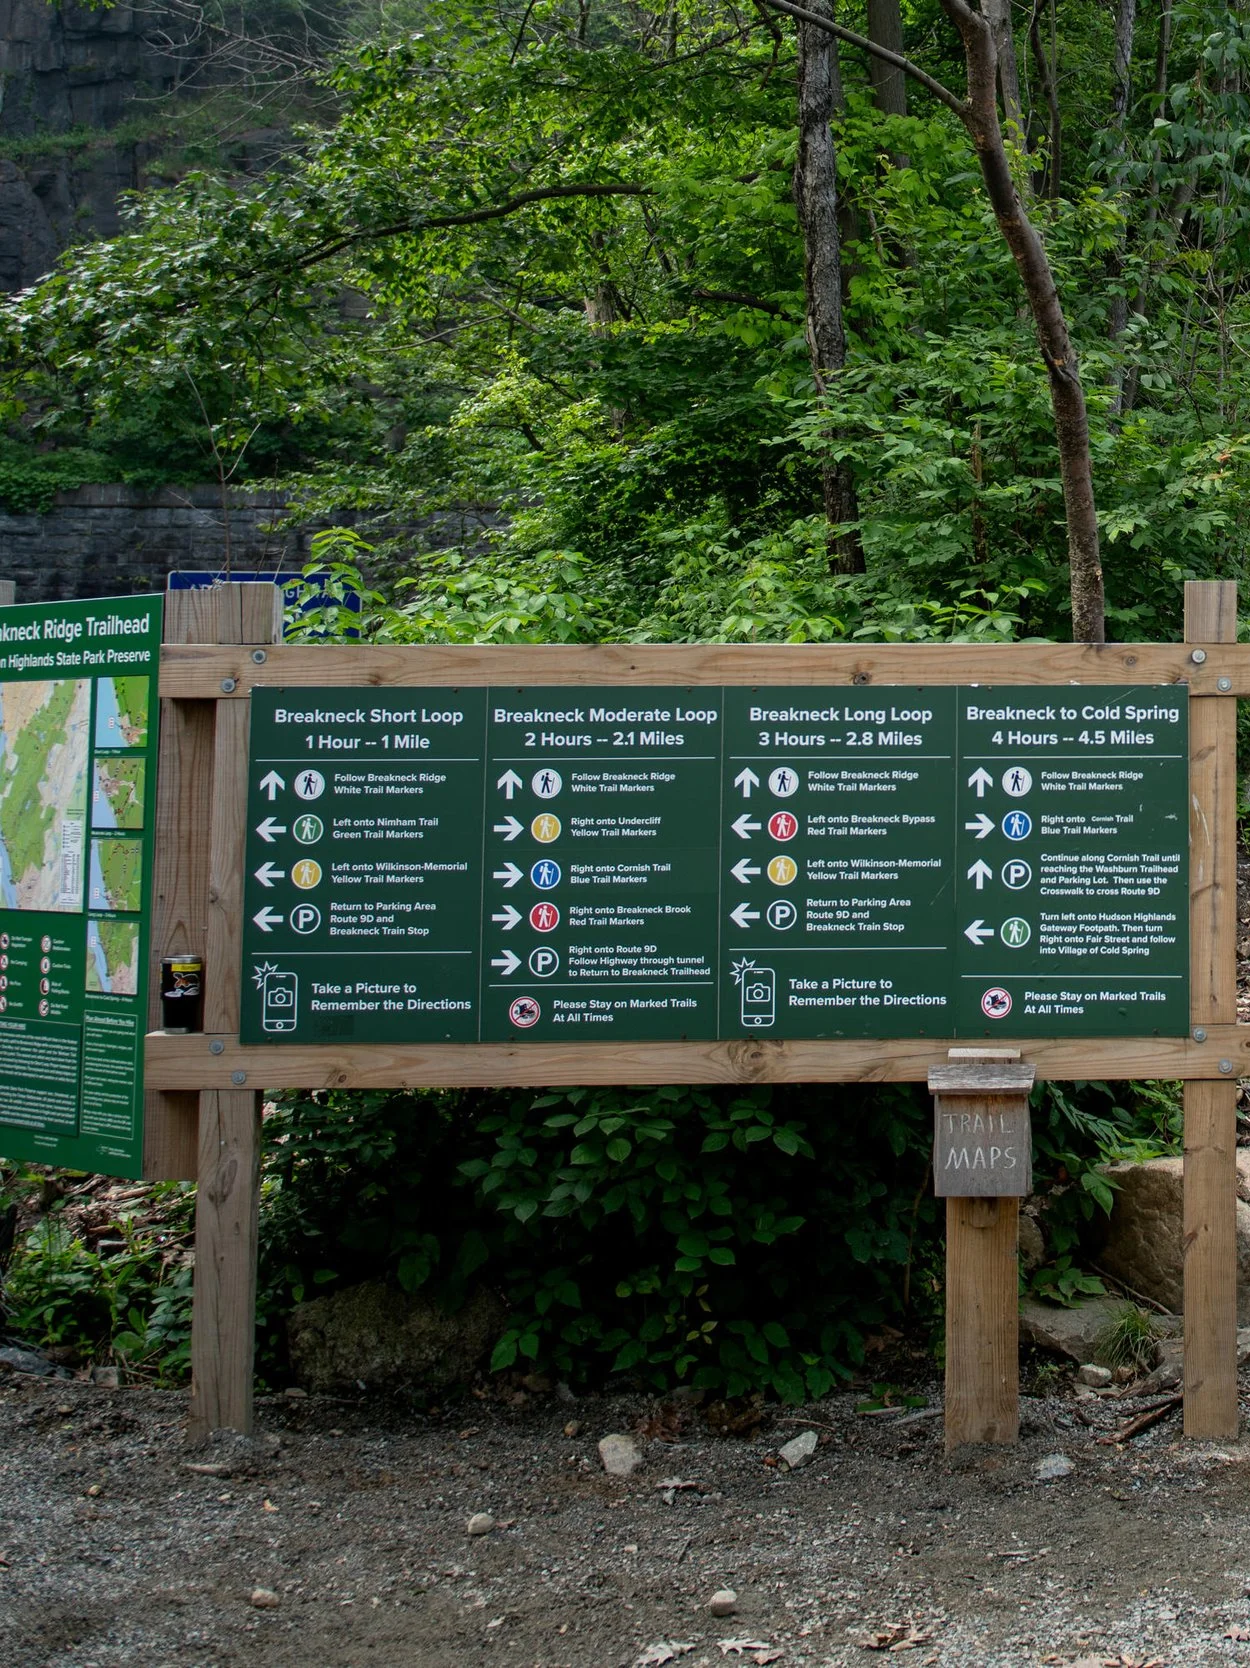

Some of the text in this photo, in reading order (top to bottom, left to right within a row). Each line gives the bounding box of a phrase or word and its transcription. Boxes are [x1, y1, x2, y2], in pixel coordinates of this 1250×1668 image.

[0, 613, 150, 643] kneck Ridge Trailhead
[8, 653, 54, 671] Highlands
[56, 652, 81, 666] State
[83, 650, 105, 665] Park
[107, 649, 151, 663] Preserve
[275, 708, 463, 725] Breakneck Short Loop
[494, 708, 717, 725] Breakneck Moderate Loop
[750, 707, 932, 724] Breakneck Long Loop
[967, 706, 1179, 723] Breakneck to Cold Spring
[306, 735, 430, 749] 1 Hour 1 Mile
[525, 732, 684, 746] 2 Hours 2.1 Miles
[759, 732, 922, 745] 3 Hours 2.8 Miles
[992, 731, 1154, 744] 4 Hours 4.5 Miles
[419, 774, 446, 783] Ridge
[334, 786, 361, 794] White
[364, 786, 383, 794] Trail
[353, 818, 375, 826] onto
[377, 818, 416, 826] Nimham
[419, 818, 438, 826] Trail
[571, 817, 661, 827] Right onto Undercliff
[851, 815, 900, 823] Breakneck
[902, 815, 935, 825] Bypass
[1041, 815, 1064, 824] Right
[850, 859, 941, 867] Wilkinson-Memorial
[1081, 854, 1105, 863] along
[1010, 865, 1025, 884] P
[1041, 866, 1077, 874] reaching
[1079, 865, 1093, 873] the
[1095, 865, 1138, 873] Washburn
[1059, 877, 1091, 886] Parking
[376, 902, 412, 912] Parking
[414, 902, 436, 910] Area
[570, 907, 593, 916] Right
[595, 906, 615, 914] onto
[298, 909, 314, 929] P
[1134, 913, 1176, 922] Highlands
[330, 927, 429, 936] Breakneck Train Stop
[1040, 924, 1077, 933] Gateway
[1079, 924, 1120, 933] Footpath.
[1040, 936, 1062, 945] Right
[569, 946, 592, 955] Right
[644, 945, 657, 953] 9D
[1058, 947, 1087, 956] Village
[1122, 947, 1149, 956] Spring
[537, 953, 553, 972] P
[569, 956, 704, 966] Follow Highway through tunnel
[611, 968, 620, 976] to
[622, 968, 668, 976] Breakneck
[312, 983, 341, 993] Take
[356, 983, 400, 993] Picture
[403, 983, 416, 993] to
[311, 999, 471, 1010] Remember the Directions
[553, 1000, 587, 1009] Please
[589, 1000, 612, 1011] Stay
[630, 999, 667, 1008] Marked
[670, 999, 697, 1008] Trails
[553, 1013, 613, 1022] At All Times
[942, 1113, 1014, 1134] TRAIL
[945, 1146, 1016, 1169] MAPS
